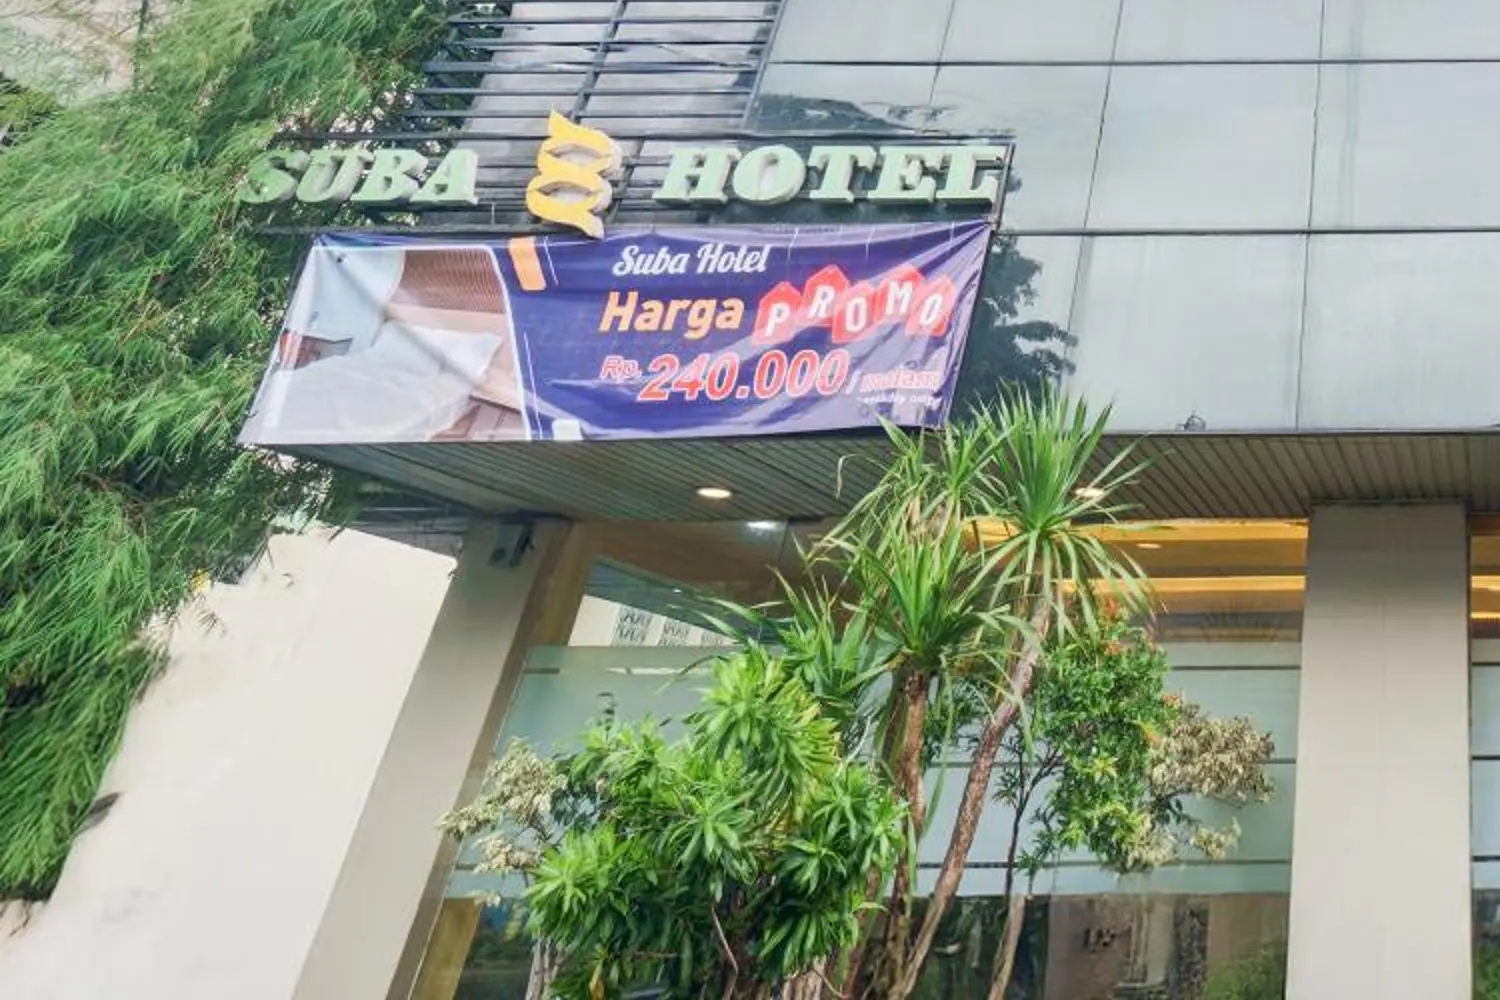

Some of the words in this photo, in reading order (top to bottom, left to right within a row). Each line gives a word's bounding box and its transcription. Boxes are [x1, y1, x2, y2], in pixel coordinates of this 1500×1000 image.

[236, 148, 479, 205] SUBA
[652, 144, 1006, 206] HOTEL
[612, 244, 687, 277] Suba
[693, 242, 772, 275] Hotel
[599, 289, 745, 340] Harga
[765, 280, 946, 338] PROMO
[637, 349, 850, 401] 240.000
